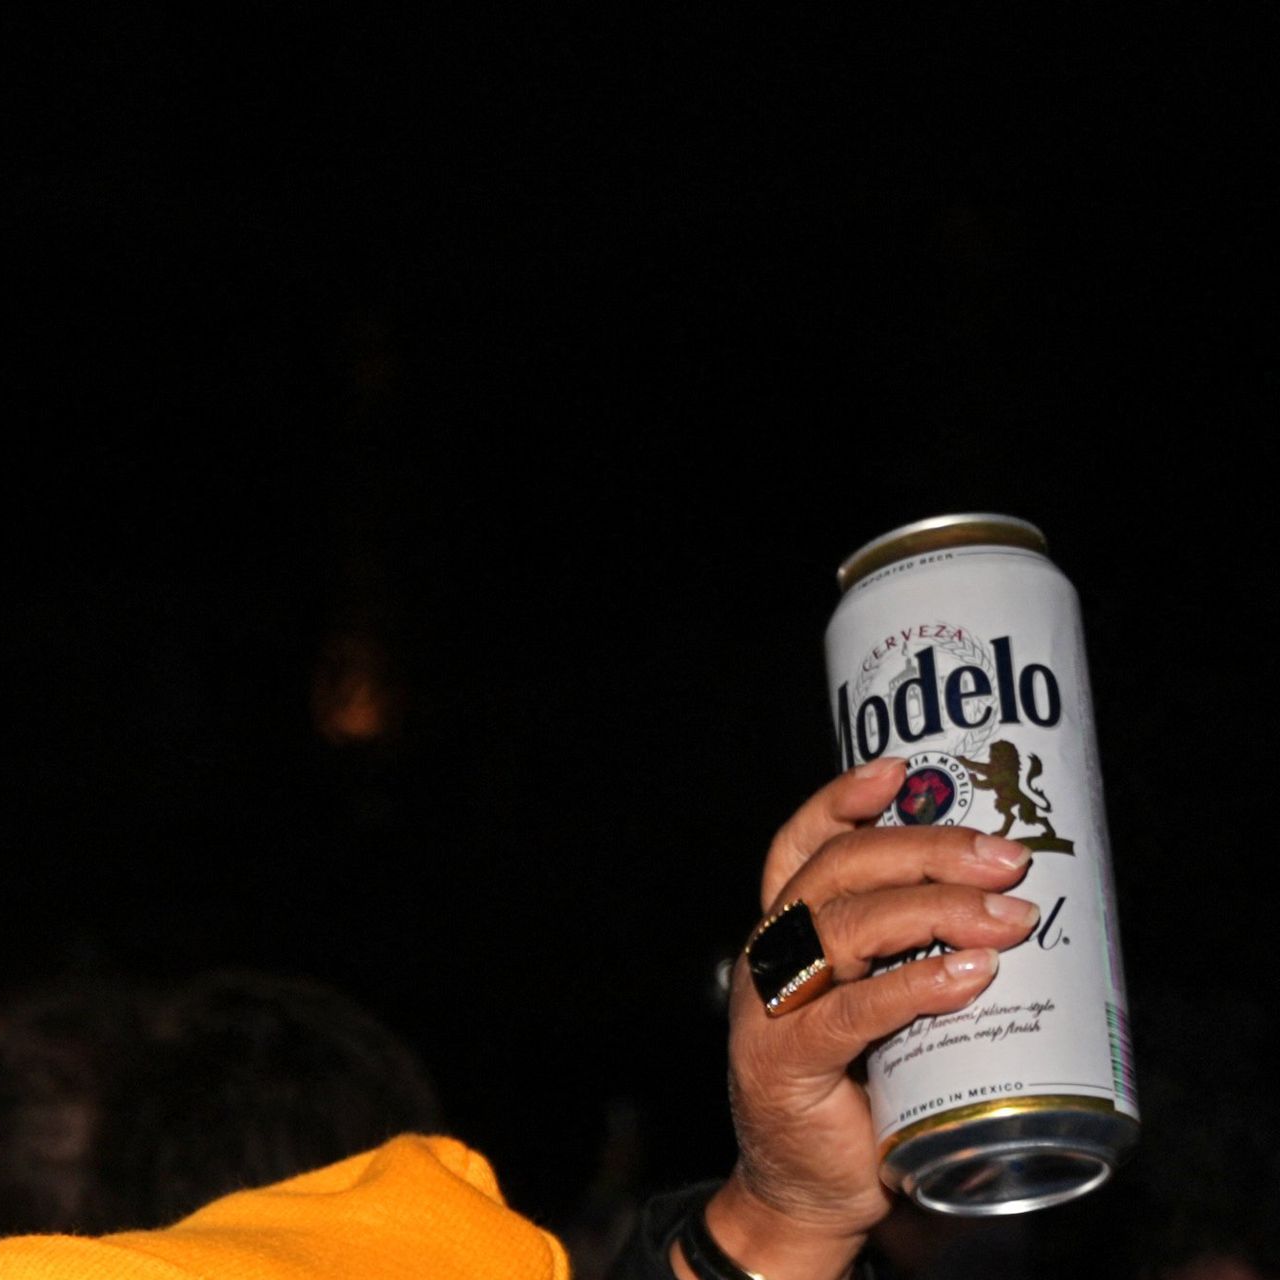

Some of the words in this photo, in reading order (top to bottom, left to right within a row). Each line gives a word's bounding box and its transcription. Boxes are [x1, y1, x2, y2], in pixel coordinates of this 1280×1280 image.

[861, 623, 966, 673] CERVEZA
[937, 756, 970, 808] MODELO
[1000, 1018, 1041, 1042] finish
[899, 1097, 944, 1122] BREWED
[949, 1093, 963, 1103] IN
[967, 1081, 1024, 1098] MEXICO
